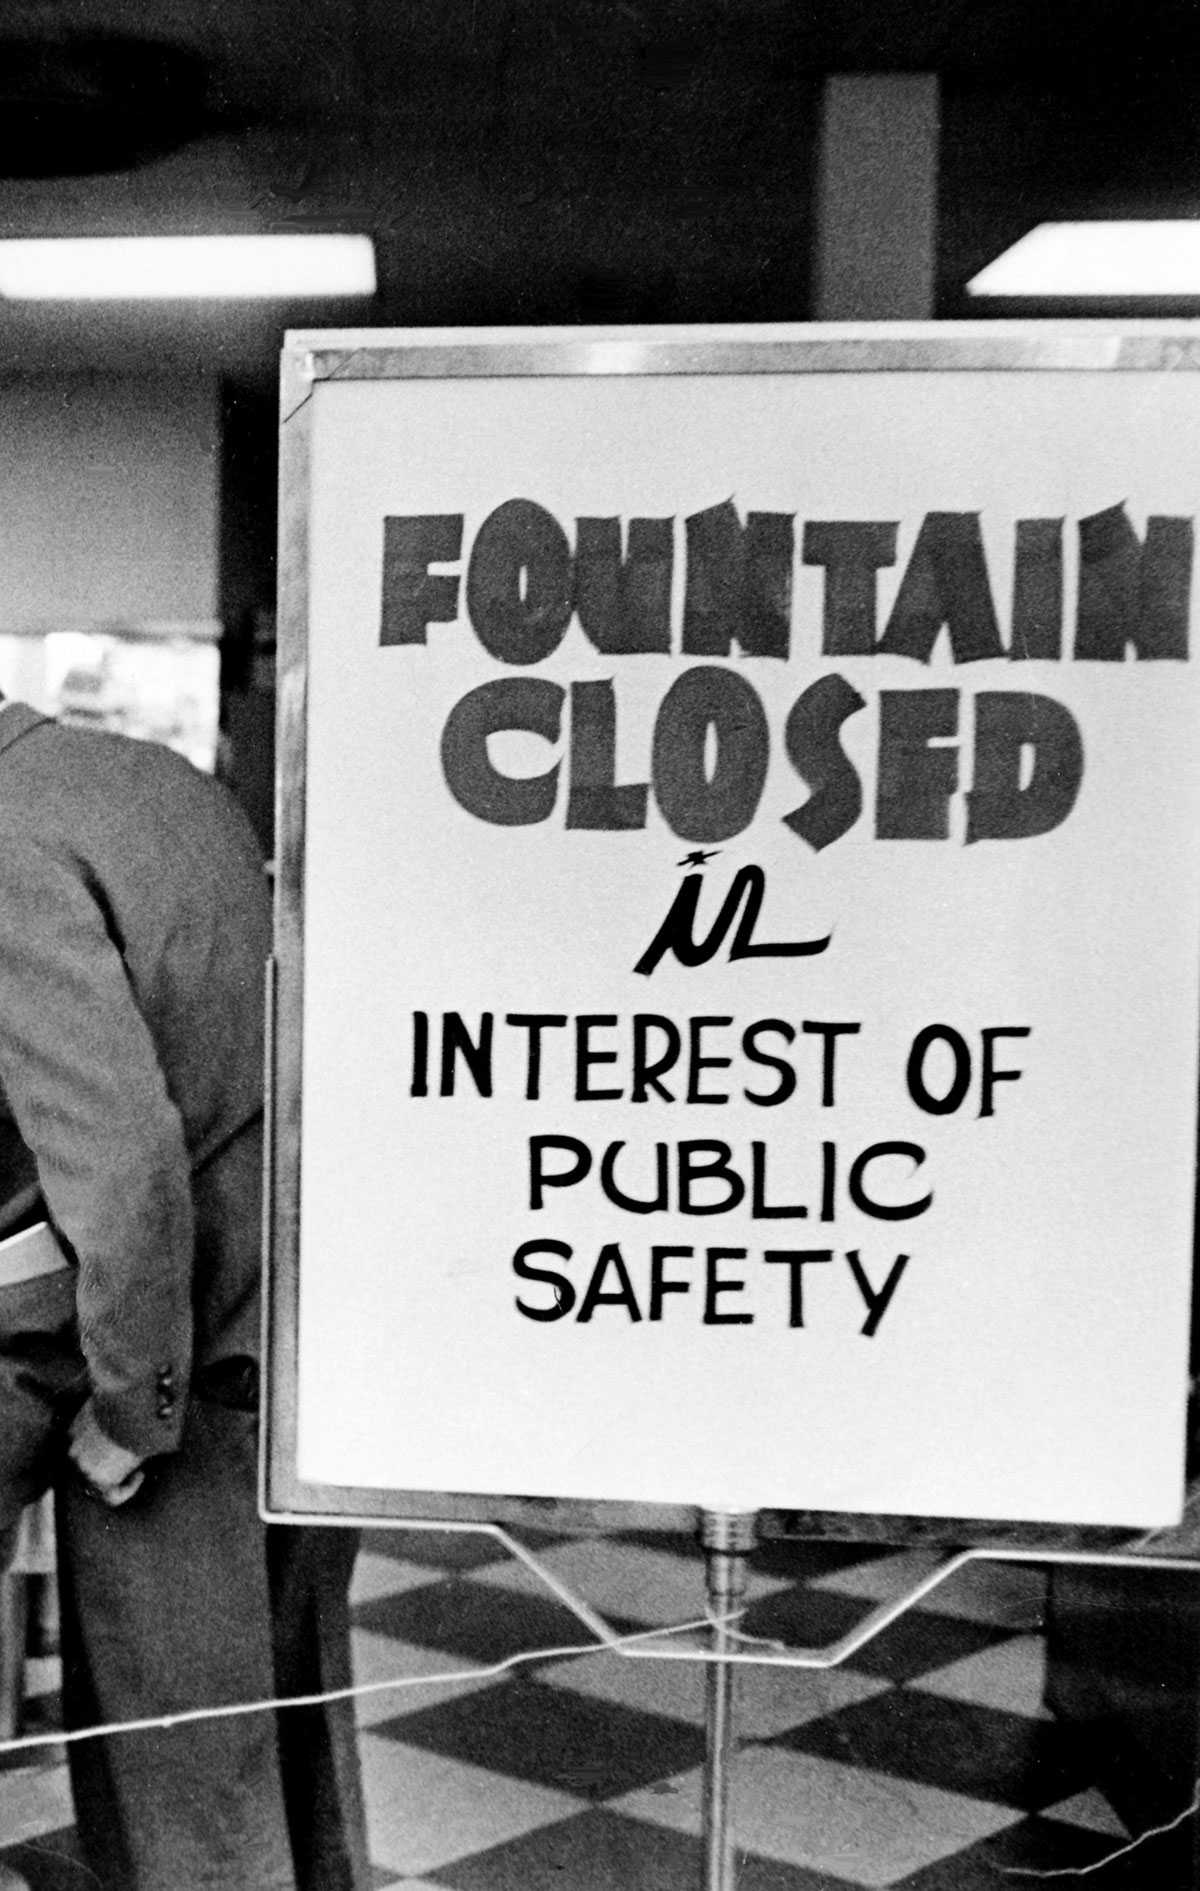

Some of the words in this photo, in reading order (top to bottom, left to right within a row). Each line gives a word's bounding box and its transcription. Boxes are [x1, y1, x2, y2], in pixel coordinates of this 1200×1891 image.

[378, 496, 1196, 667] FOUNTAIN
[439, 665, 1087, 854] CLOSED
[409, 1009, 863, 1109] INTEREST
[905, 1022, 1033, 1120] OF
[527, 1133, 934, 1224] PUBLIC
[511, 1237, 911, 1339] SAFETY
